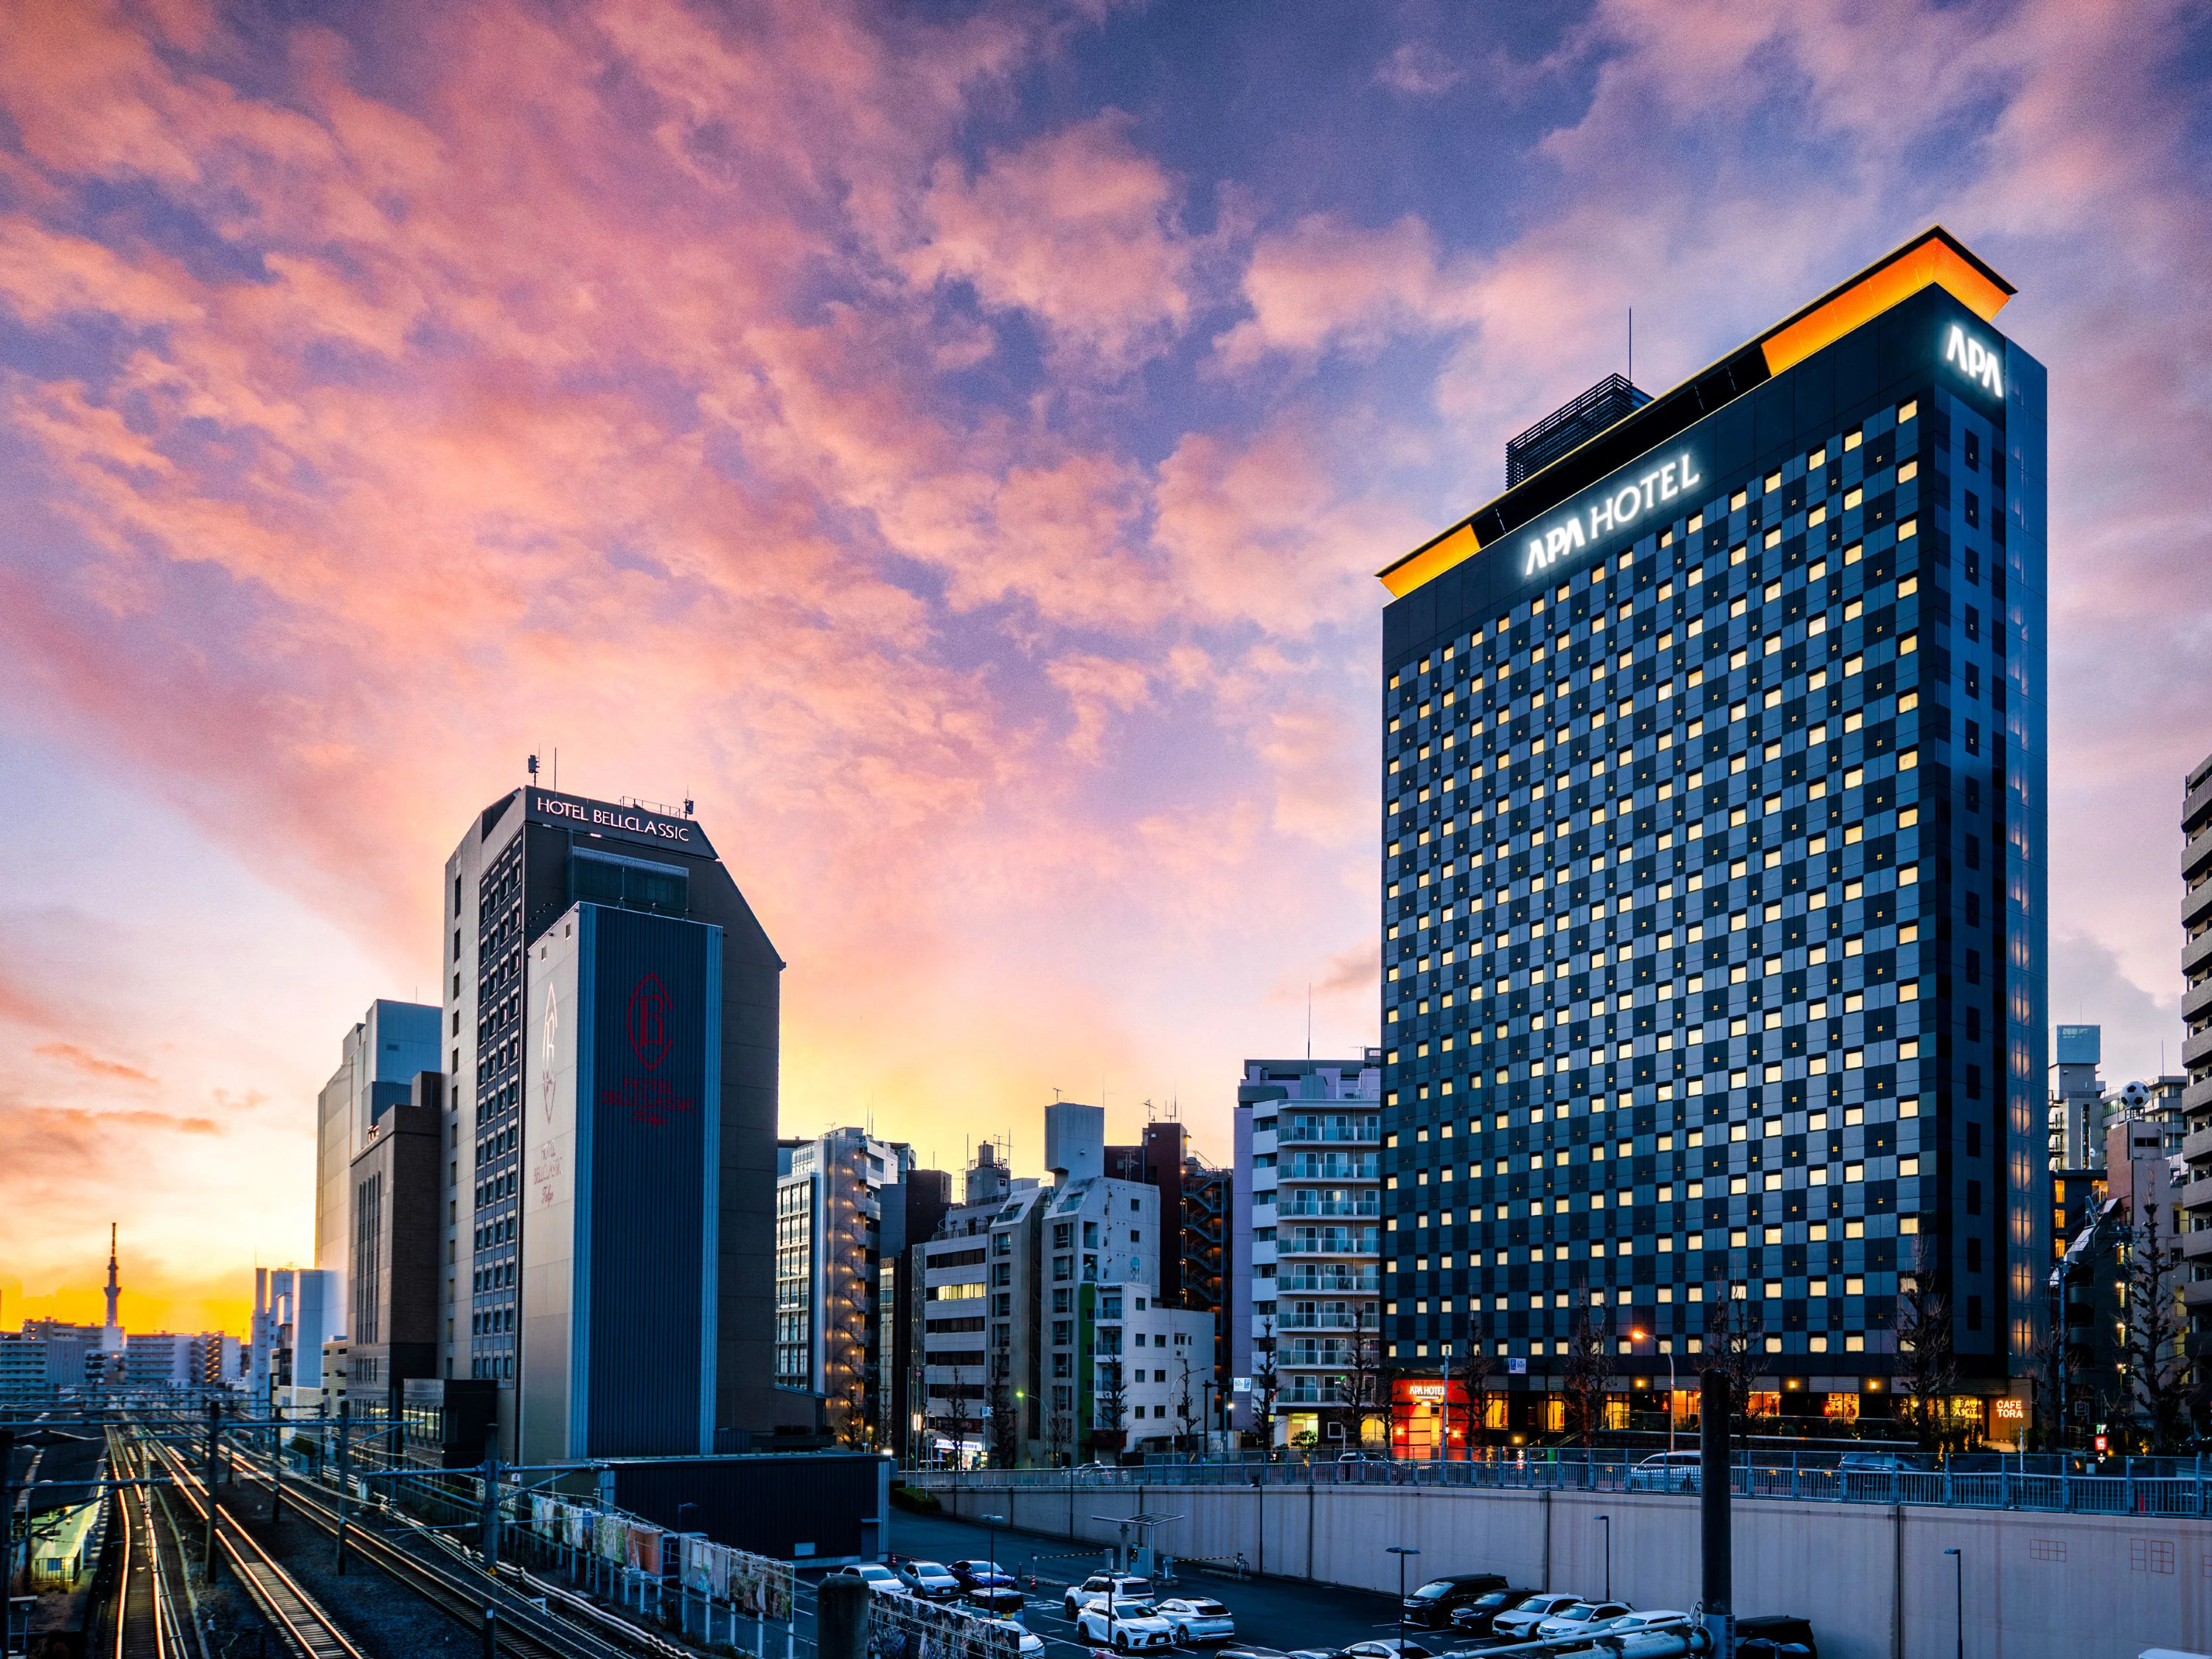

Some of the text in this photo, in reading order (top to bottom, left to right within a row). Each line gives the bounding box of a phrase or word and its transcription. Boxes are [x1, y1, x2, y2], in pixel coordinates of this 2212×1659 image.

[1947, 325, 2003, 398] APA
[1526, 453, 1700, 577] APA HOTEL
[538, 797, 689, 842] HOTEL BELLCLASSIC
[624, 1075, 676, 1095] HOTEL
[602, 1089, 696, 1113] BELLCLASSIC
[1410, 1386, 1445, 1395] APA HOTEL
[1997, 1400, 2022, 1409] CAFE
[1997, 1409, 2023, 1418] TORA
